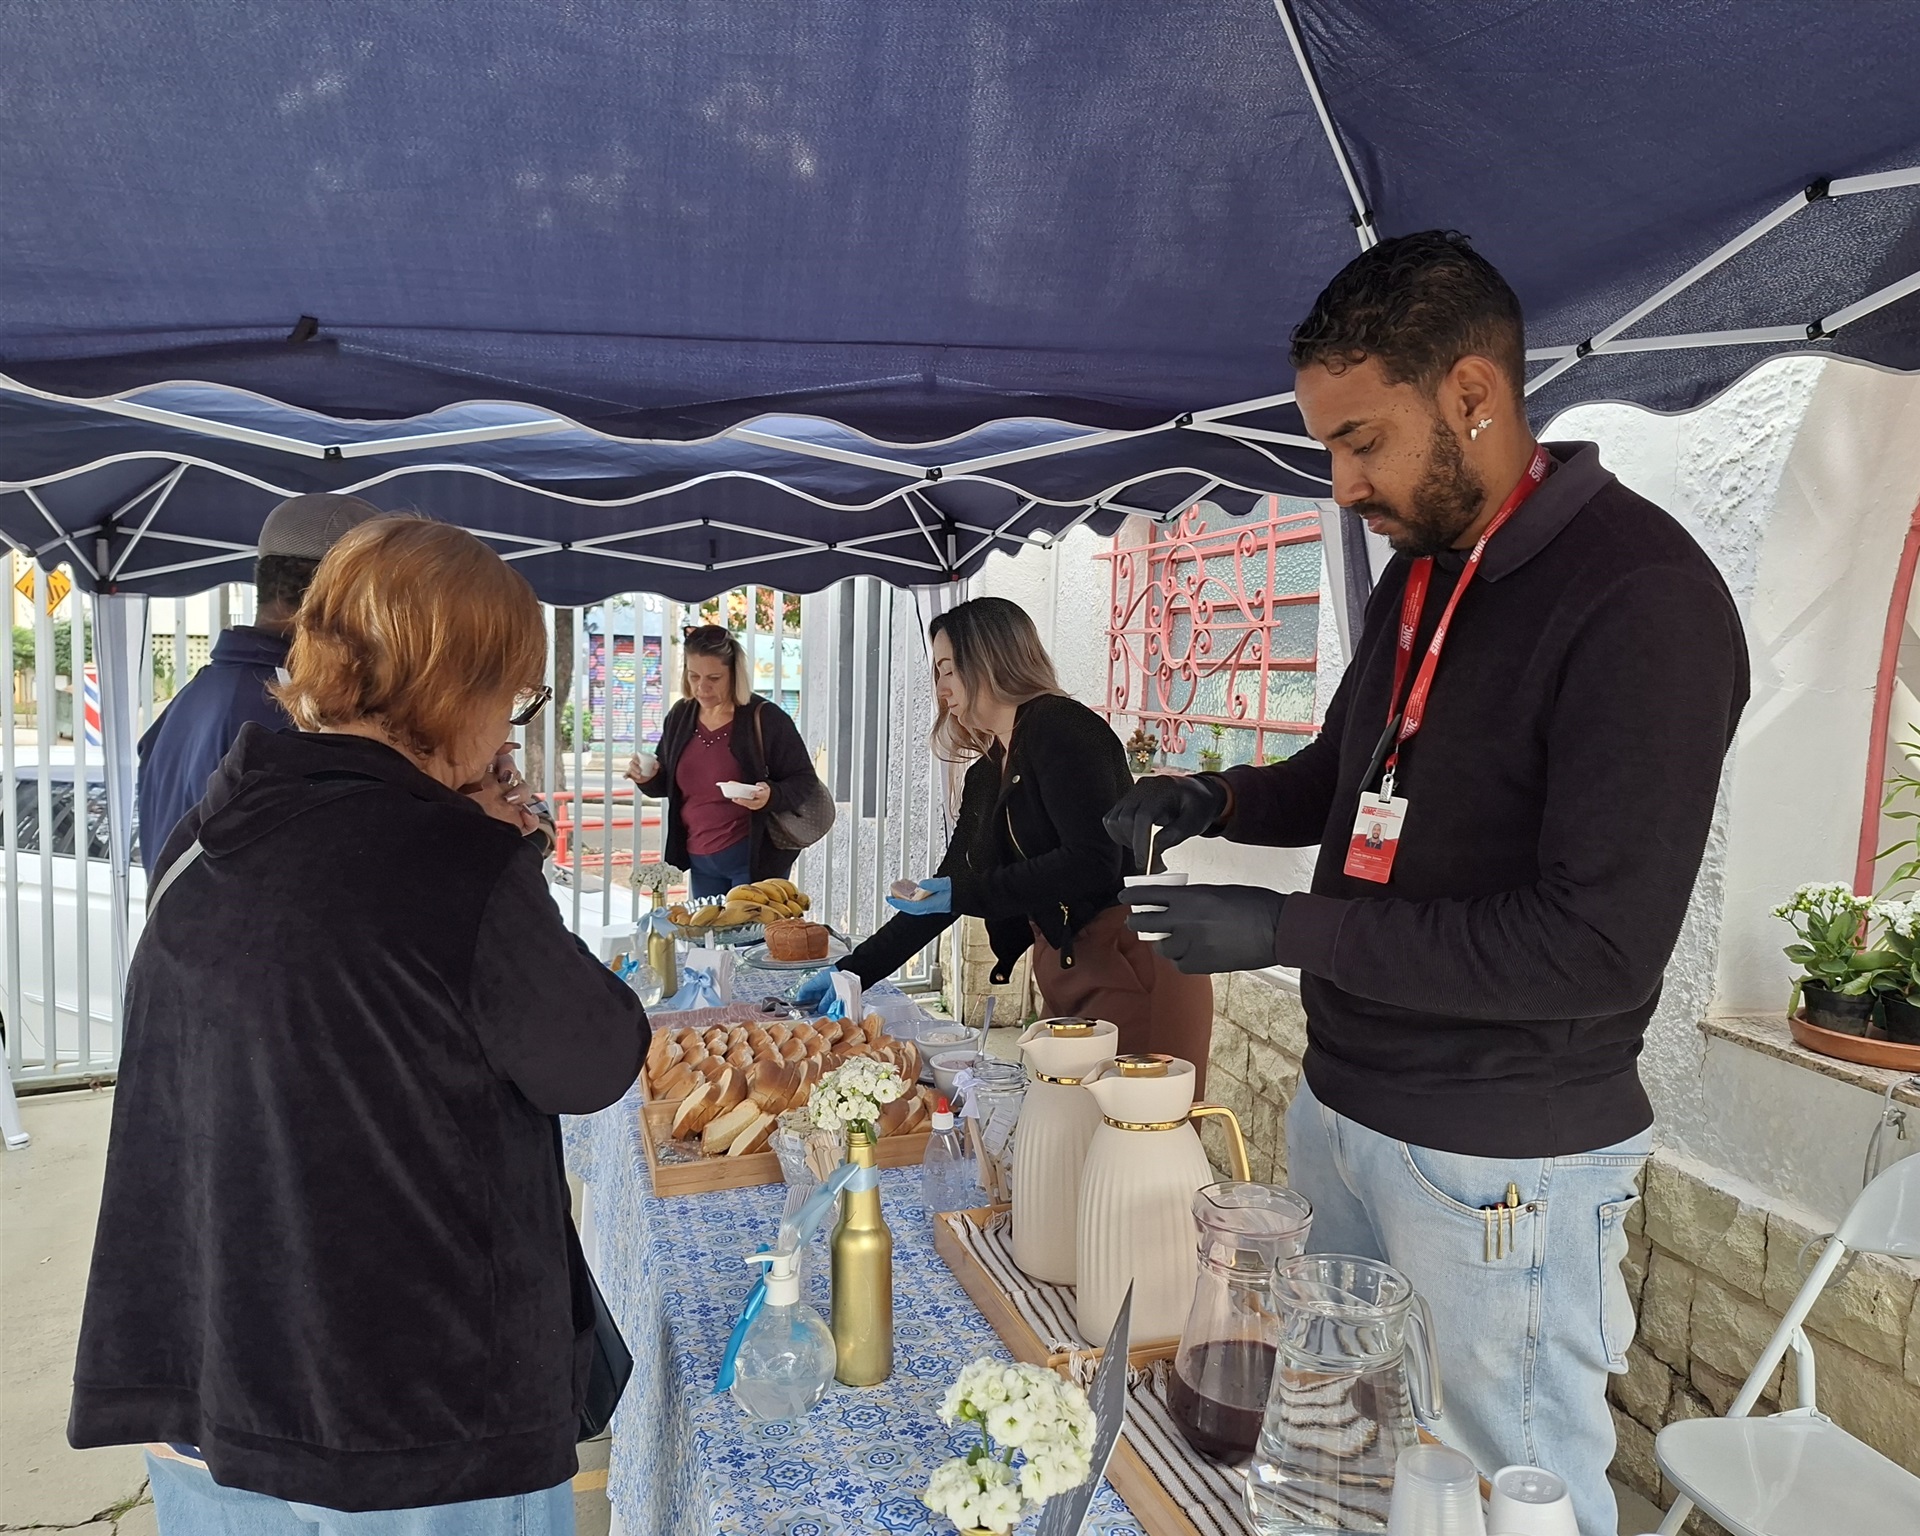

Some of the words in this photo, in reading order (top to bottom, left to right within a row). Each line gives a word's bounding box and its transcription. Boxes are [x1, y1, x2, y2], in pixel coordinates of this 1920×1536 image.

[1530, 457, 1546, 482] SIMC
[1470, 535, 1489, 563] SIMC
[1400, 624, 1414, 651] SIMC
[1429, 627, 1445, 656] SIMC
